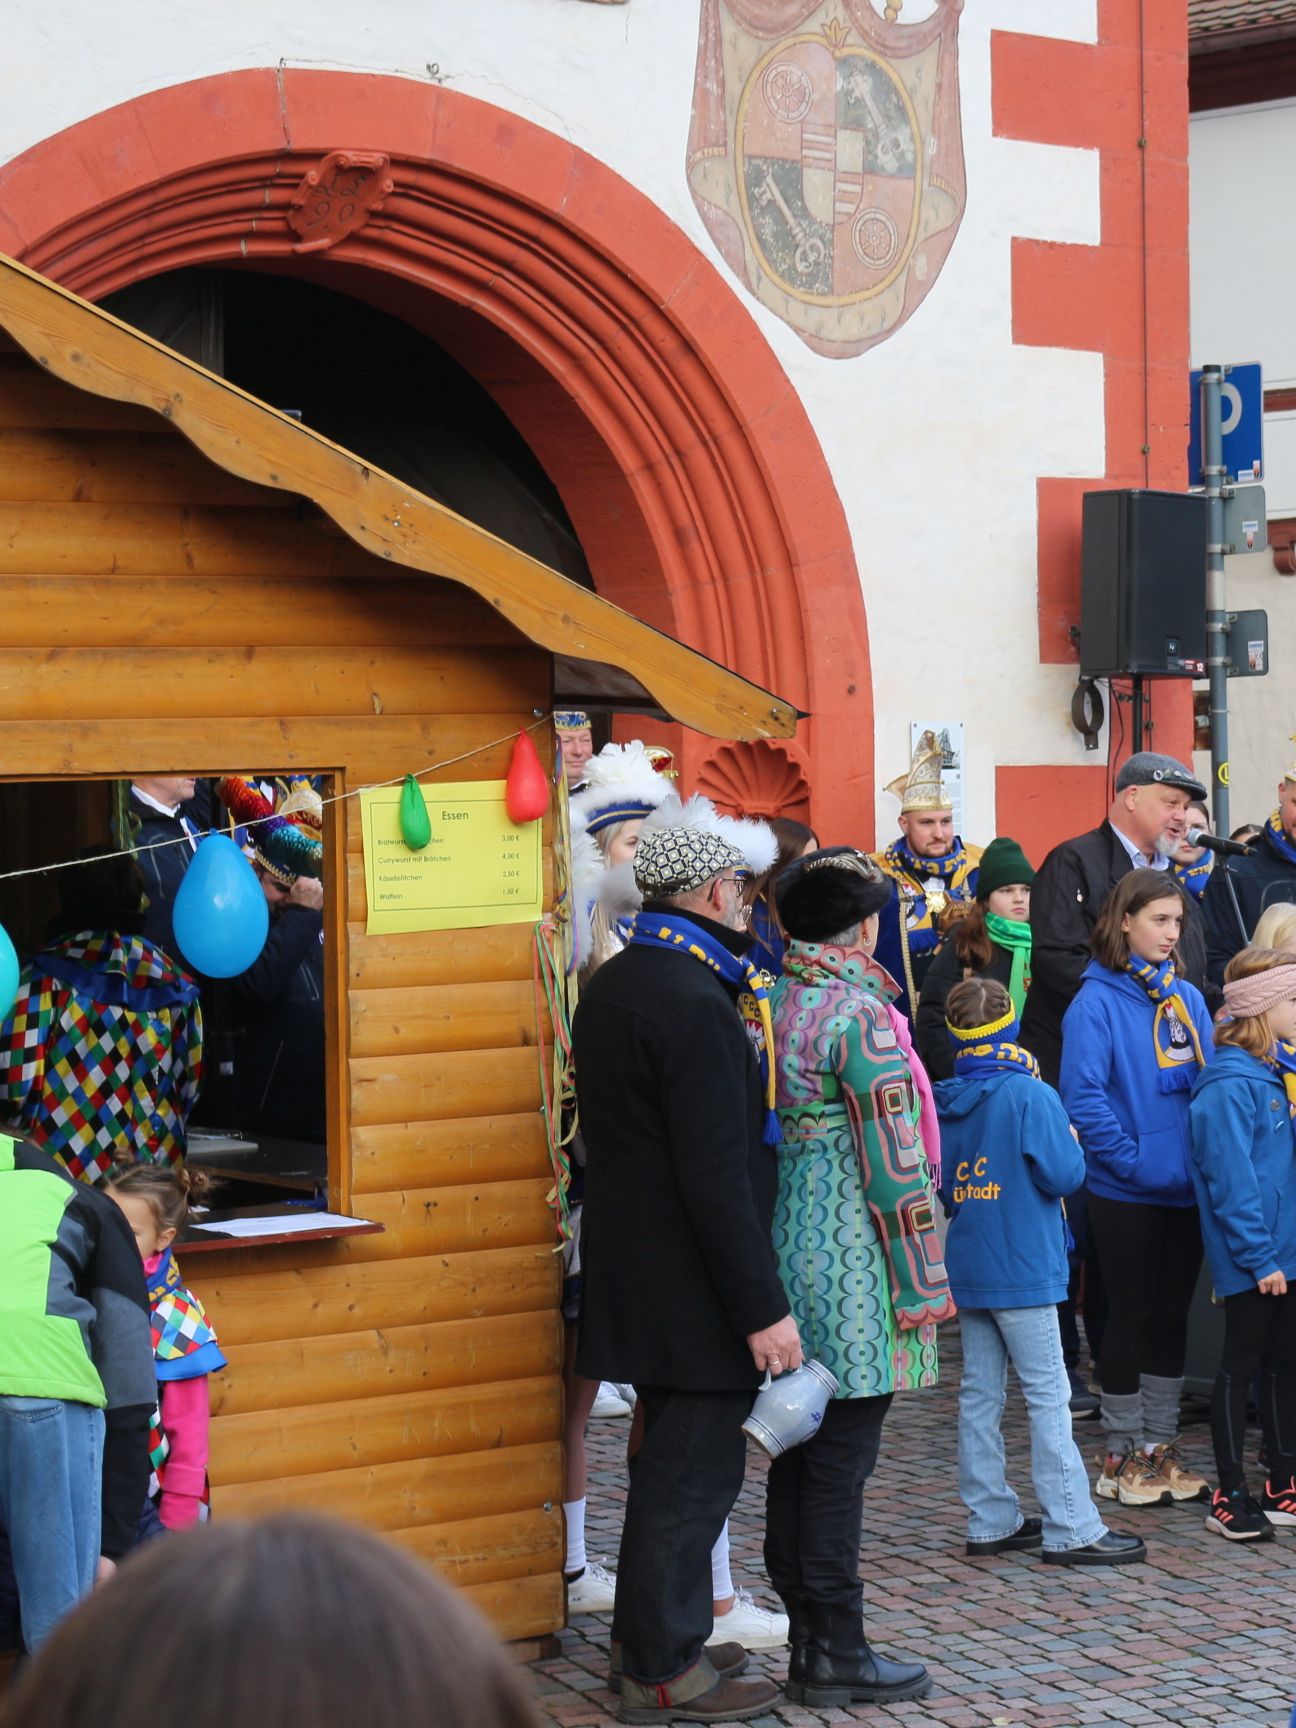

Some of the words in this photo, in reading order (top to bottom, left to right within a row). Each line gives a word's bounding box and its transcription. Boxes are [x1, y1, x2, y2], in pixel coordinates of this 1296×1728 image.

[441, 811, 469, 821] Essen
[378, 856, 411, 864] Currywurst
[378, 874, 423, 882] Käsebrötchen
